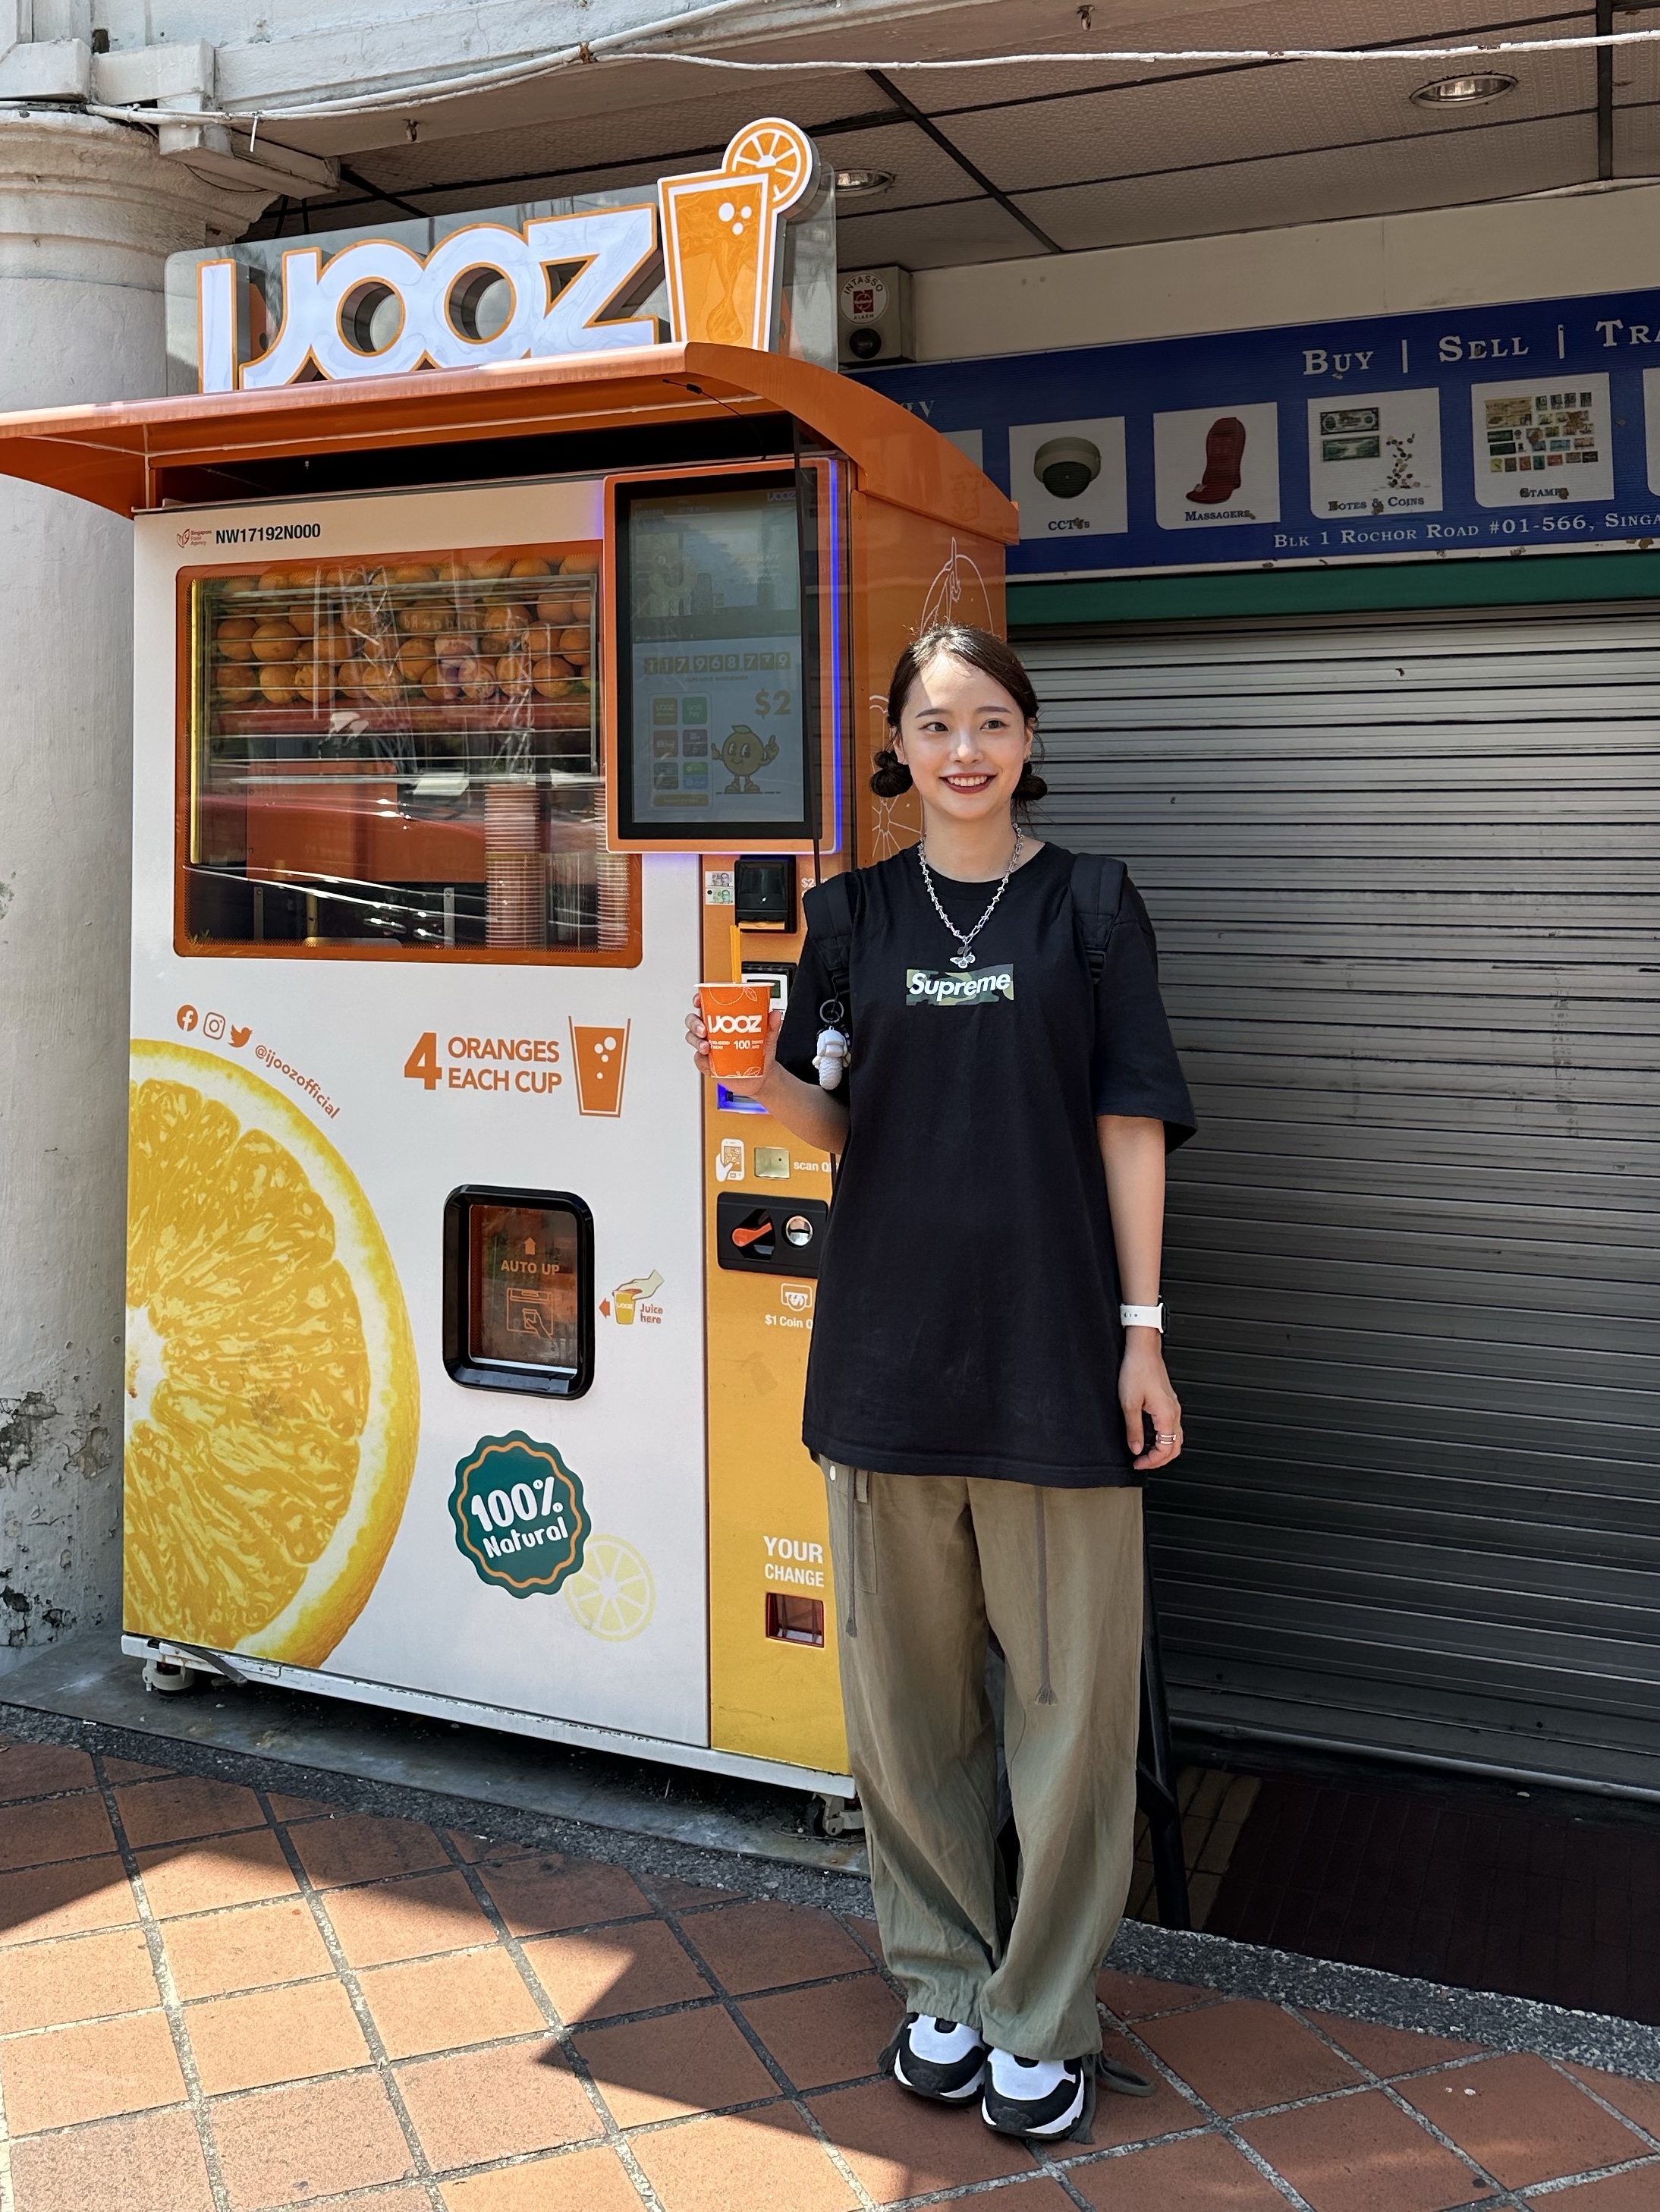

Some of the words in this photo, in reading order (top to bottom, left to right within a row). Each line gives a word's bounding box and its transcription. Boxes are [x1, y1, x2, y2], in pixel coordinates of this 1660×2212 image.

[844, 275, 883, 294] INTASSO
[1520, 487, 1568, 498] STAMP
[216, 524, 321, 544] NW17192N000
[1321, 532, 1329, 545] 1
[1489, 514, 1595, 534] #01-566,
[754, 688, 791, 719] $2
[910, 972, 1011, 1002] Supreme
[404, 1032, 442, 1090] 4
[448, 1037, 560, 1062] ORANGES
[255, 1045, 341, 1119] @ijoozofficial
[448, 1067, 509, 1091] EACH
[515, 1071, 562, 1093] CUP
[793, 1161, 819, 1172] scan
[501, 1260, 537, 1274] AUTO
[541, 1263, 560, 1275] UP
[640, 1304, 663, 1314] Juice
[640, 1313, 662, 1323] here
[765, 1314, 777, 1326] $1
[780, 1316, 803, 1329] Coin
[471, 1476, 564, 1532] 100%
[483, 1516, 569, 1559] Natural
[763, 1535, 823, 1564] YOUR
[765, 1563, 825, 1588] CHANGE
